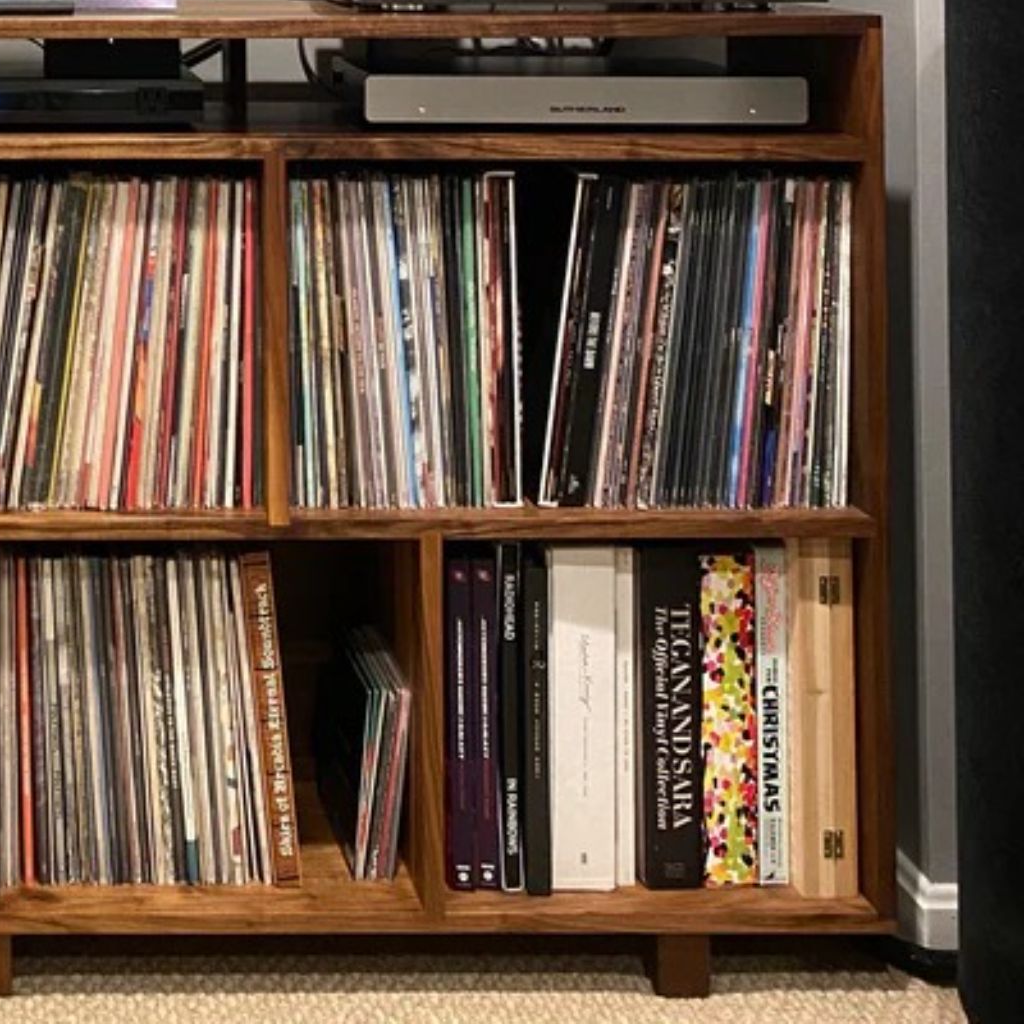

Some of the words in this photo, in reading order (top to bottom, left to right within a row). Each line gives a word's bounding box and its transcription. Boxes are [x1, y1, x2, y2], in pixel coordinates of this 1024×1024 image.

[654, 606, 668, 634] The
[652, 638, 669, 698] Official
[653, 702, 670, 744] Vinyl
[762, 684, 780, 813] CHRISTMAS
[656, 745, 671, 830] Collection
